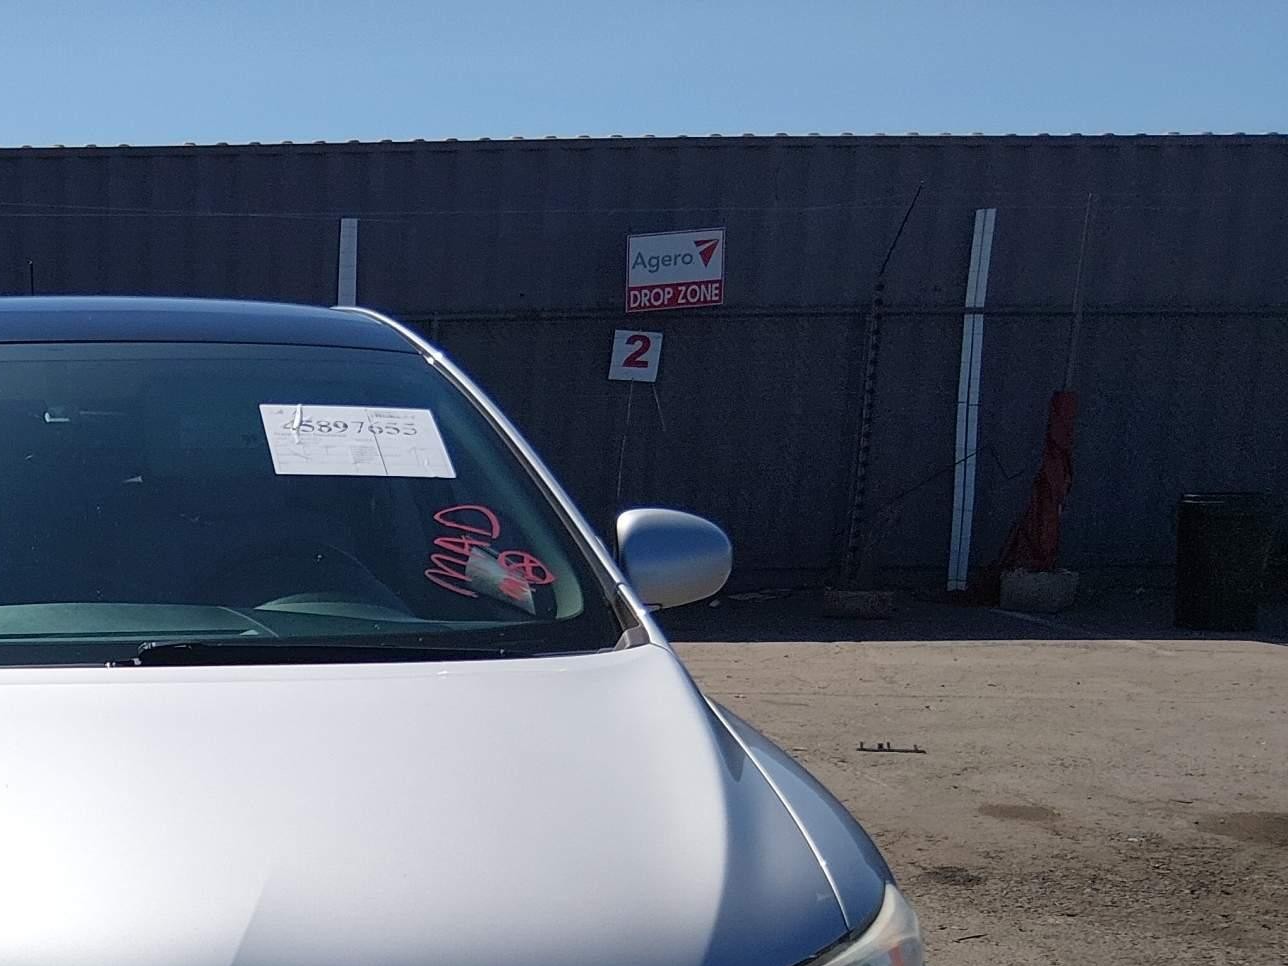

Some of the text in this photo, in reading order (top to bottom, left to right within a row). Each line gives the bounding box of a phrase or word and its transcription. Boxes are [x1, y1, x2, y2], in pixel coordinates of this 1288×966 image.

[631, 251, 694, 273] Agero
[630, 283, 720, 308] DROP ZONE
[622, 334, 651, 368] 2
